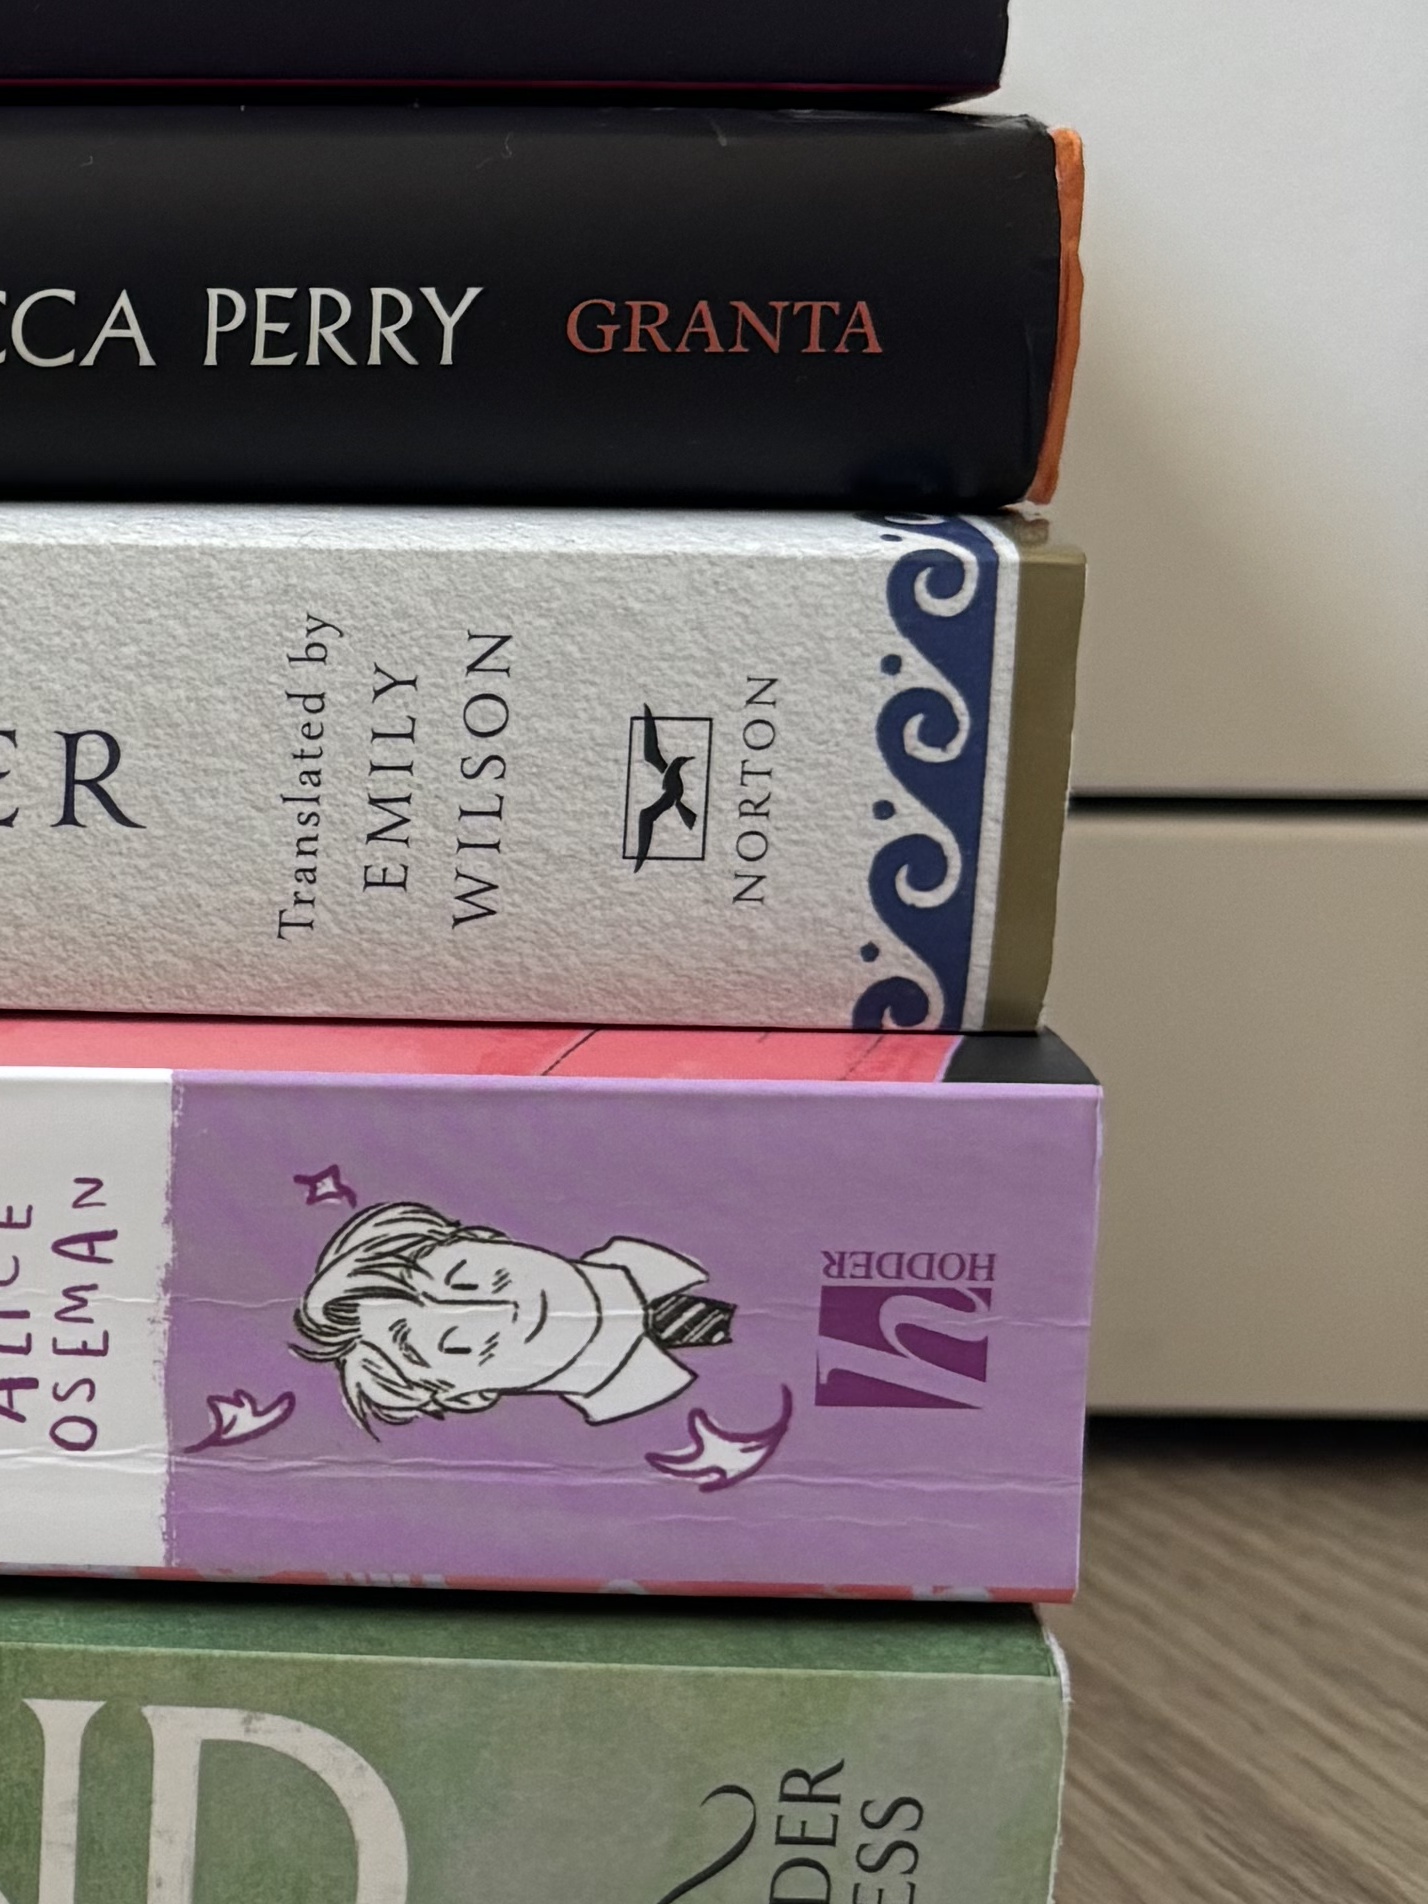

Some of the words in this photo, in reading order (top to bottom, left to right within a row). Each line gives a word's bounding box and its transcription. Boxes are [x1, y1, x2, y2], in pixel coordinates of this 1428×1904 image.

[204, 286, 483, 367] PERRY
[565, 298, 884, 356] GRANTA
[286, 612, 345, 665] by
[276, 691, 326, 941] Translated
[362, 663, 419, 893] EMILY
[451, 631, 514, 930] WILSON
[731, 675, 780, 905] NORTON
[48, 1176, 120, 1453] OSEMAN
[820, 1250, 997, 1282] HODDER
